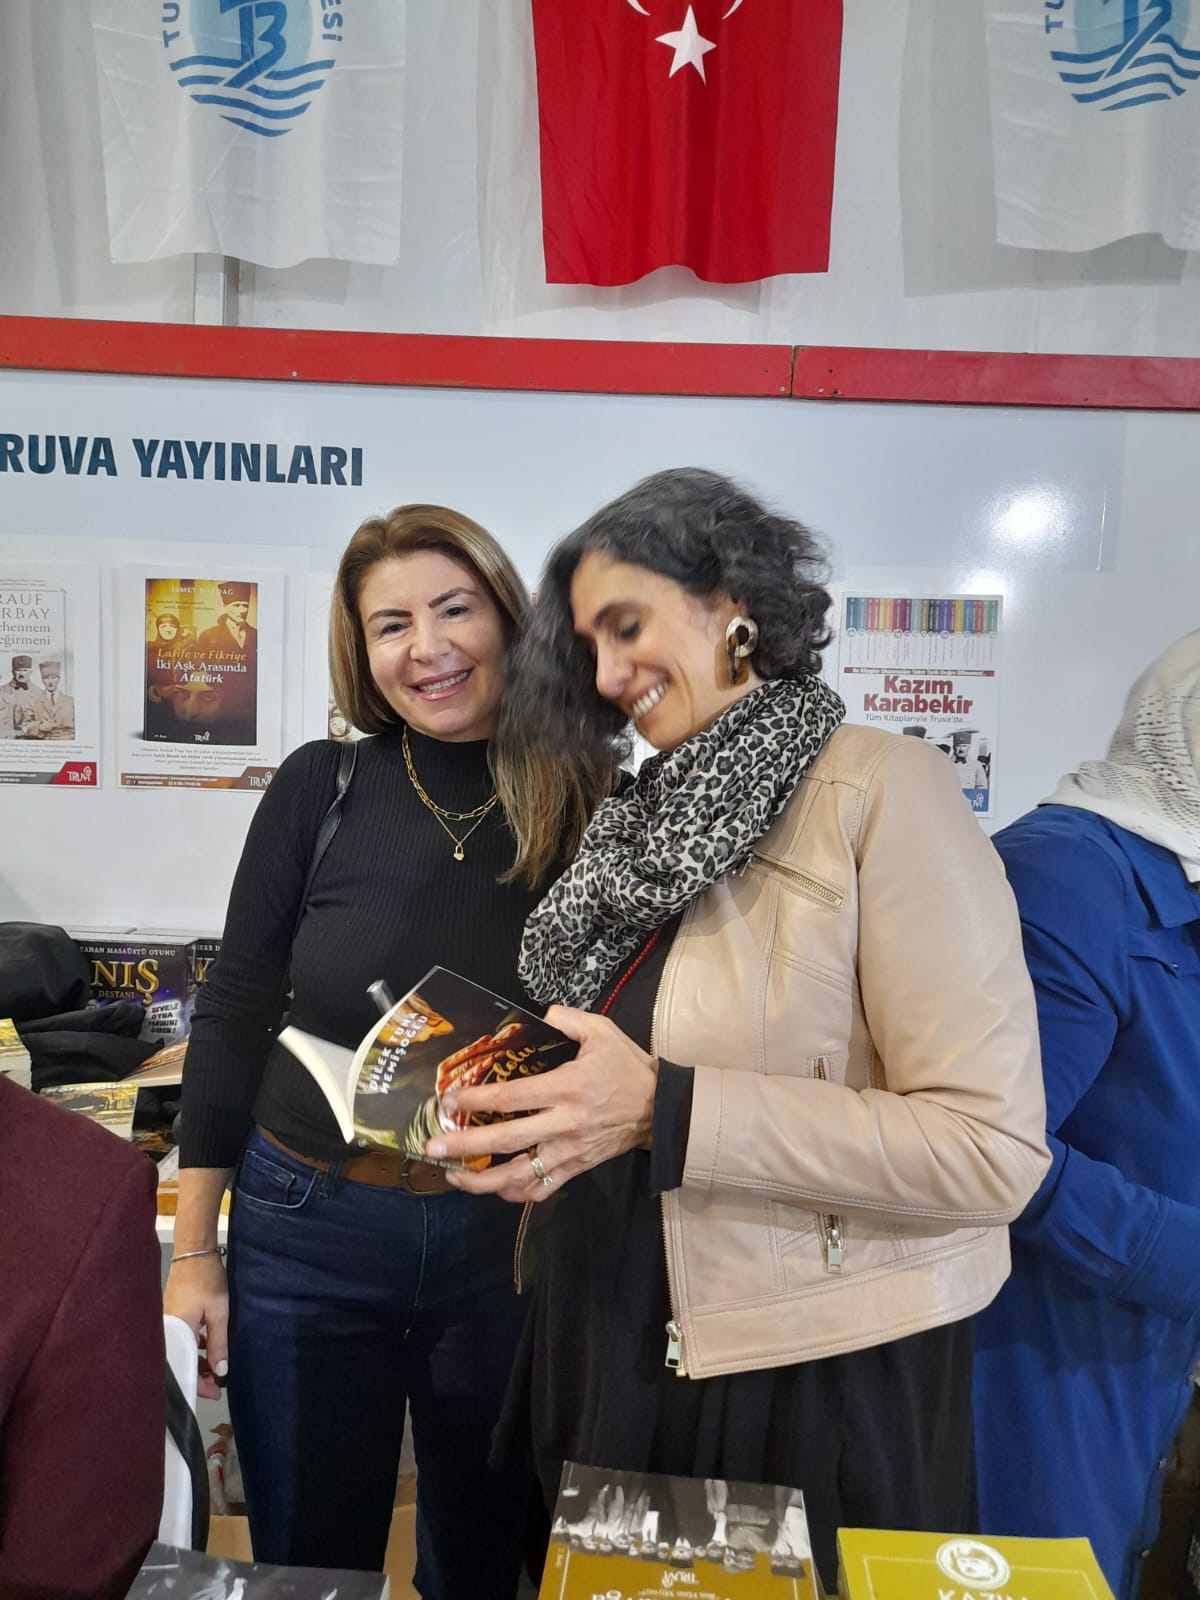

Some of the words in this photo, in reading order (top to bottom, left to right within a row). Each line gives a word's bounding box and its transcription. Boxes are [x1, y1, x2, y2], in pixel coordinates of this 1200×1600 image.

[131, 438, 363, 486] YAYINLARI
[174, 660, 196, 672] Aşk
[198, 661, 247, 673] Arasında
[180, 673, 224, 684] Atatürk
[884, 675, 954, 695] Kazım
[863, 693, 974, 715] Karabekir
[865, 713, 882, 721] Tüm
[368, 1046, 393, 1092] DİLEK
[388, 1012, 420, 1043] TUNA
